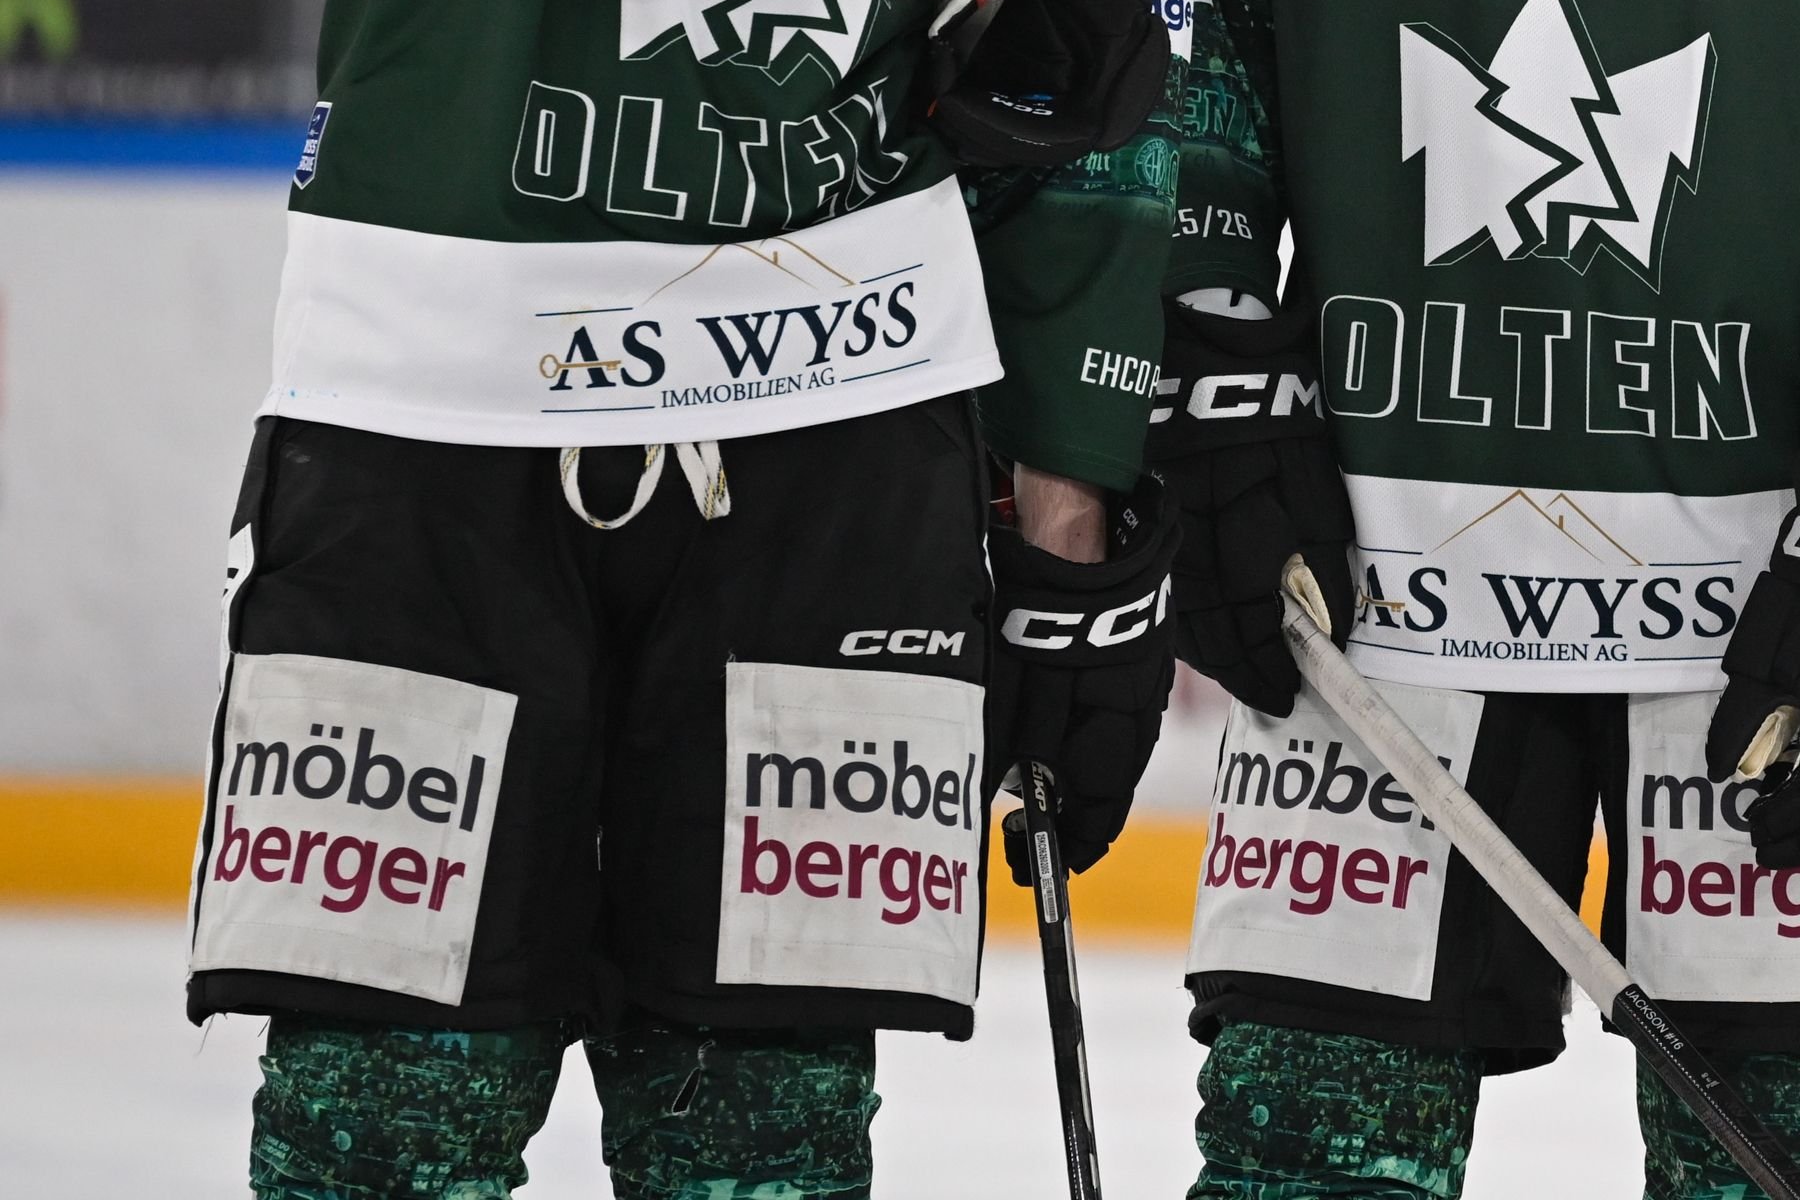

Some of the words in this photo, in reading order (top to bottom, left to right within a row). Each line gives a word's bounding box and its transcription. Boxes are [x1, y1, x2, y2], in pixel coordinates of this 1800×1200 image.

[1171, 205, 1252, 240] 5/26
[550, 319, 666, 392] AS
[696, 281, 920, 377] WYSS
[1321, 294, 1758, 442] OLTEN
[660, 374, 802, 409] IMMOBILIEN
[804, 366, 836, 389] AG
[838, 629, 965, 657] CCM
[1440, 637, 1591, 662] IMMOBILIEN
[1595, 643, 1629, 663] AG
[1483, 573, 1742, 640] WYSS
[228, 722, 486, 832] möbel
[744, 740, 973, 830] möbel
[213, 804, 466, 913] berger
[740, 815, 968, 925] berger
[1204, 812, 1429, 916] berger
[1624, 990, 1669, 1034] JACKSON
[1665, 1031, 1685, 1051] #16
